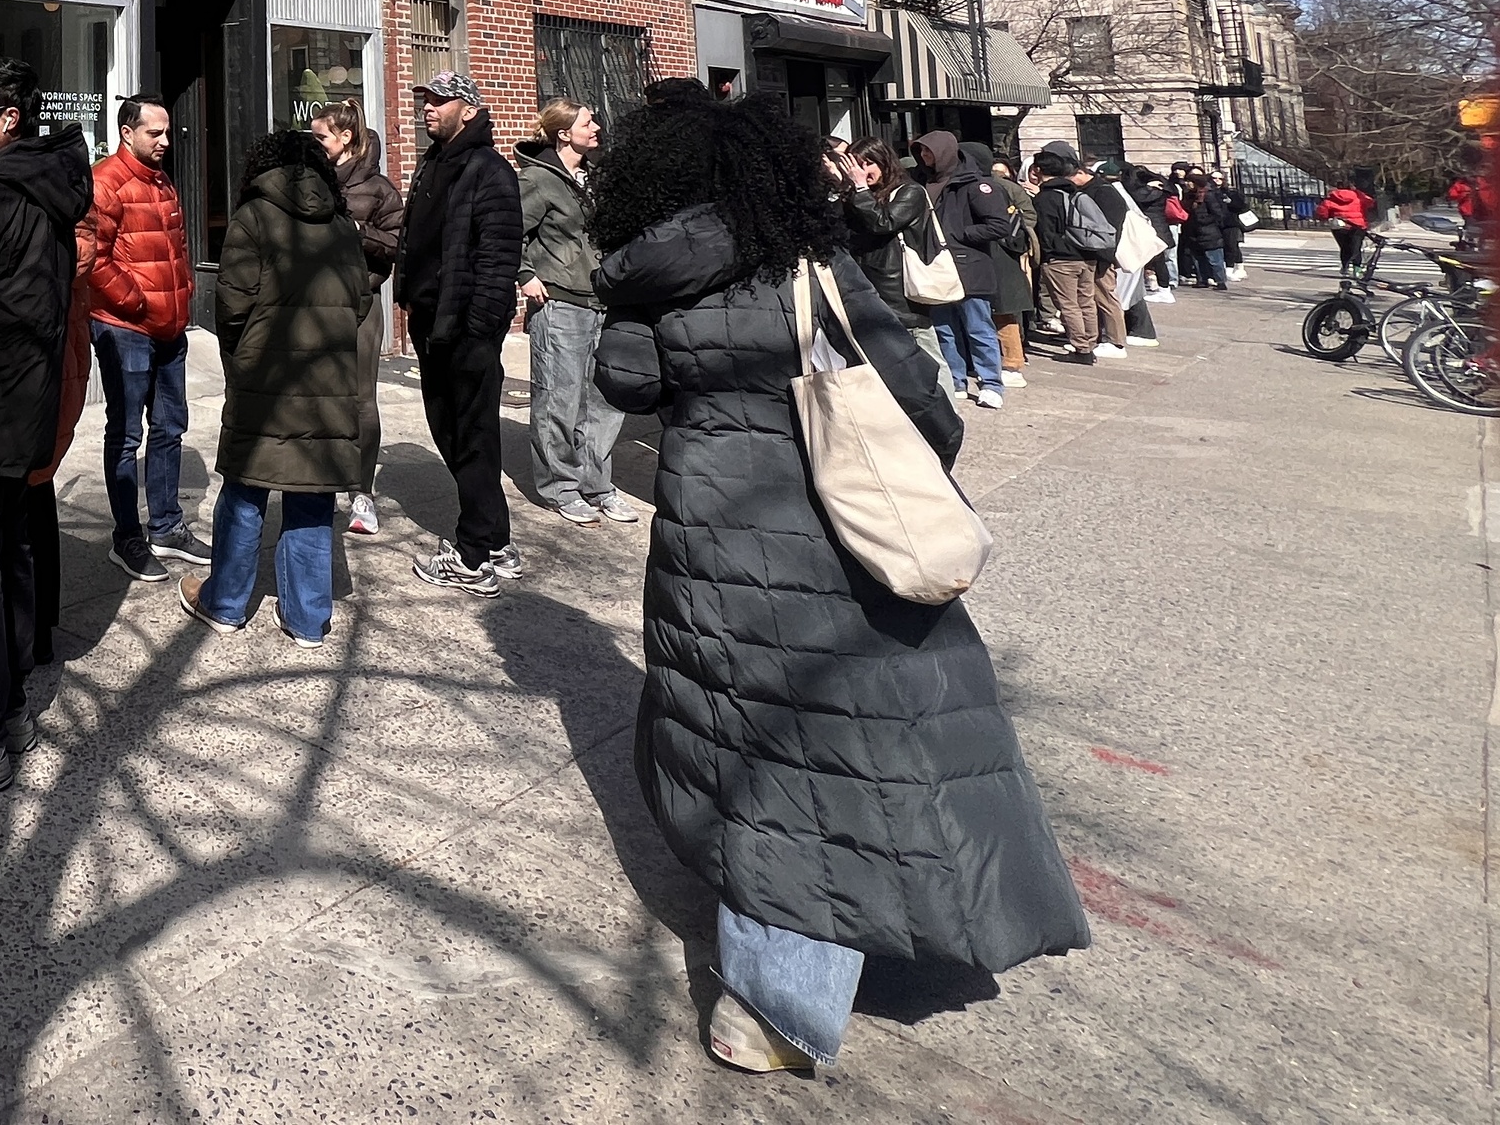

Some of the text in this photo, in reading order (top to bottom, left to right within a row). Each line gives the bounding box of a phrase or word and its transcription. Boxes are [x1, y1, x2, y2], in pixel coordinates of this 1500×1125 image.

[79, 93, 103, 102] SPACE
[46, 102, 63, 111] AND
[65, 103, 72, 111] IT
[73, 103, 80, 111] IS
[82, 103, 101, 111] ALSO
[293, 100, 332, 122] WO
[39, 112, 98, 121] OR VENUE-HIRE
